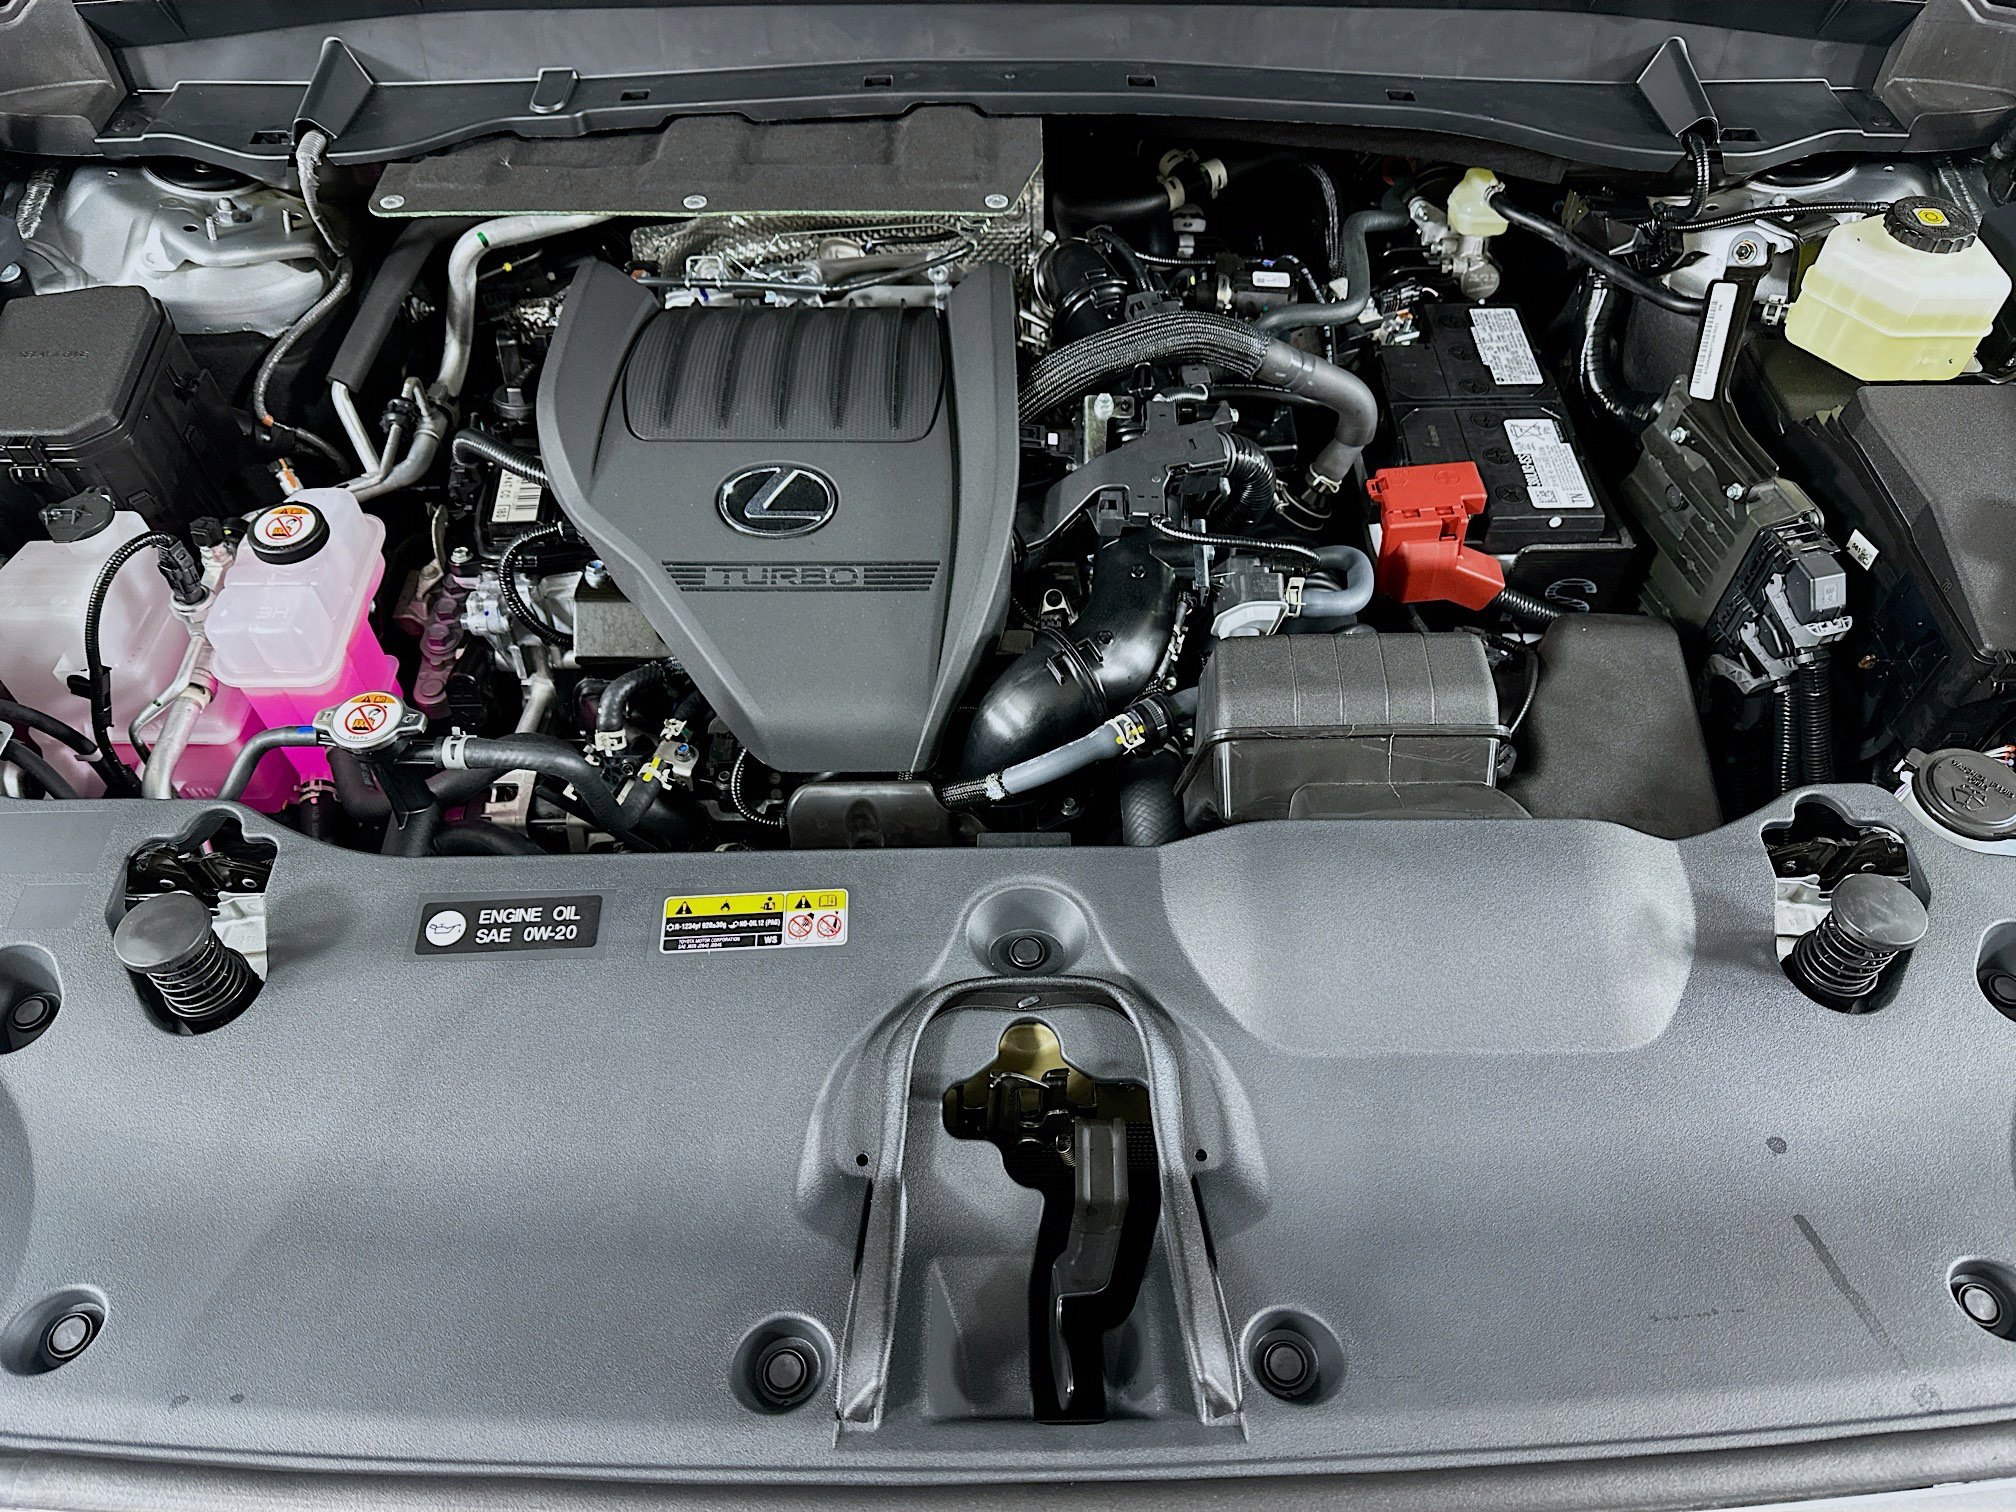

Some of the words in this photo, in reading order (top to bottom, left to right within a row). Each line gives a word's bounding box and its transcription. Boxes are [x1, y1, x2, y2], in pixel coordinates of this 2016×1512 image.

[711, 566, 859, 586] TURBO
[478, 907, 543, 925] ENGINE
[552, 905, 581, 921] OIL
[475, 927, 512, 944] SAE
[523, 925, 578, 942] 0W-20
[763, 935, 778, 944] WS
